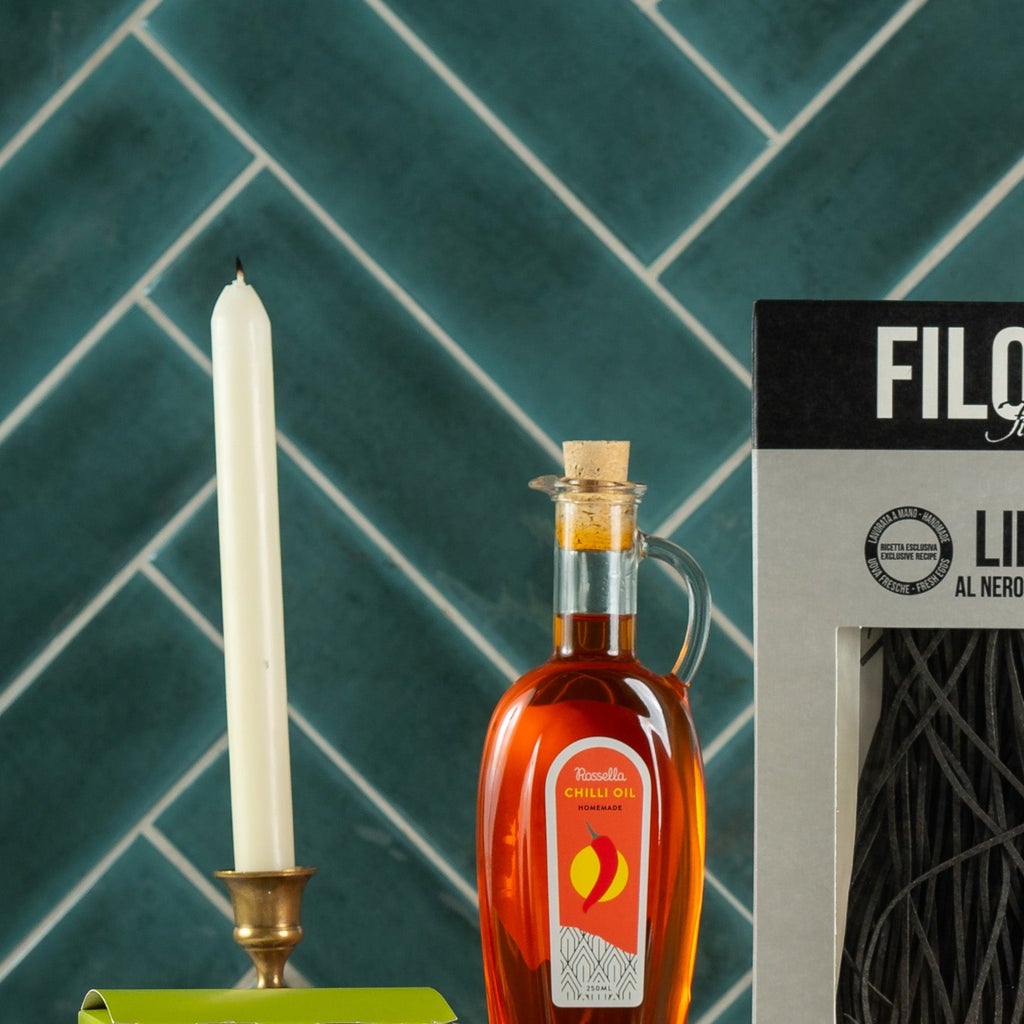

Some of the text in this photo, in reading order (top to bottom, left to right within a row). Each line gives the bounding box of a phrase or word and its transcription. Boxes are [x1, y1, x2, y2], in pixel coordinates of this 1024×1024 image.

[868, 514, 893, 544] LAVORATA
[898, 508, 918, 519] MANO
[921, 512, 950, 544] HANDMADE
[880, 543, 938, 551] RICETTA ESCLUSIVA
[880, 552, 937, 560] EXCLUSIVE RECIPE
[879, 574, 910, 594] FRESCHE
[916, 574, 940, 592] FRESH
[955, 576, 976, 598] AL
[980, 576, 1023, 598] NERO
[574, 766, 627, 782] Rossella
[564, 787, 636, 799] CHILLI OIL
